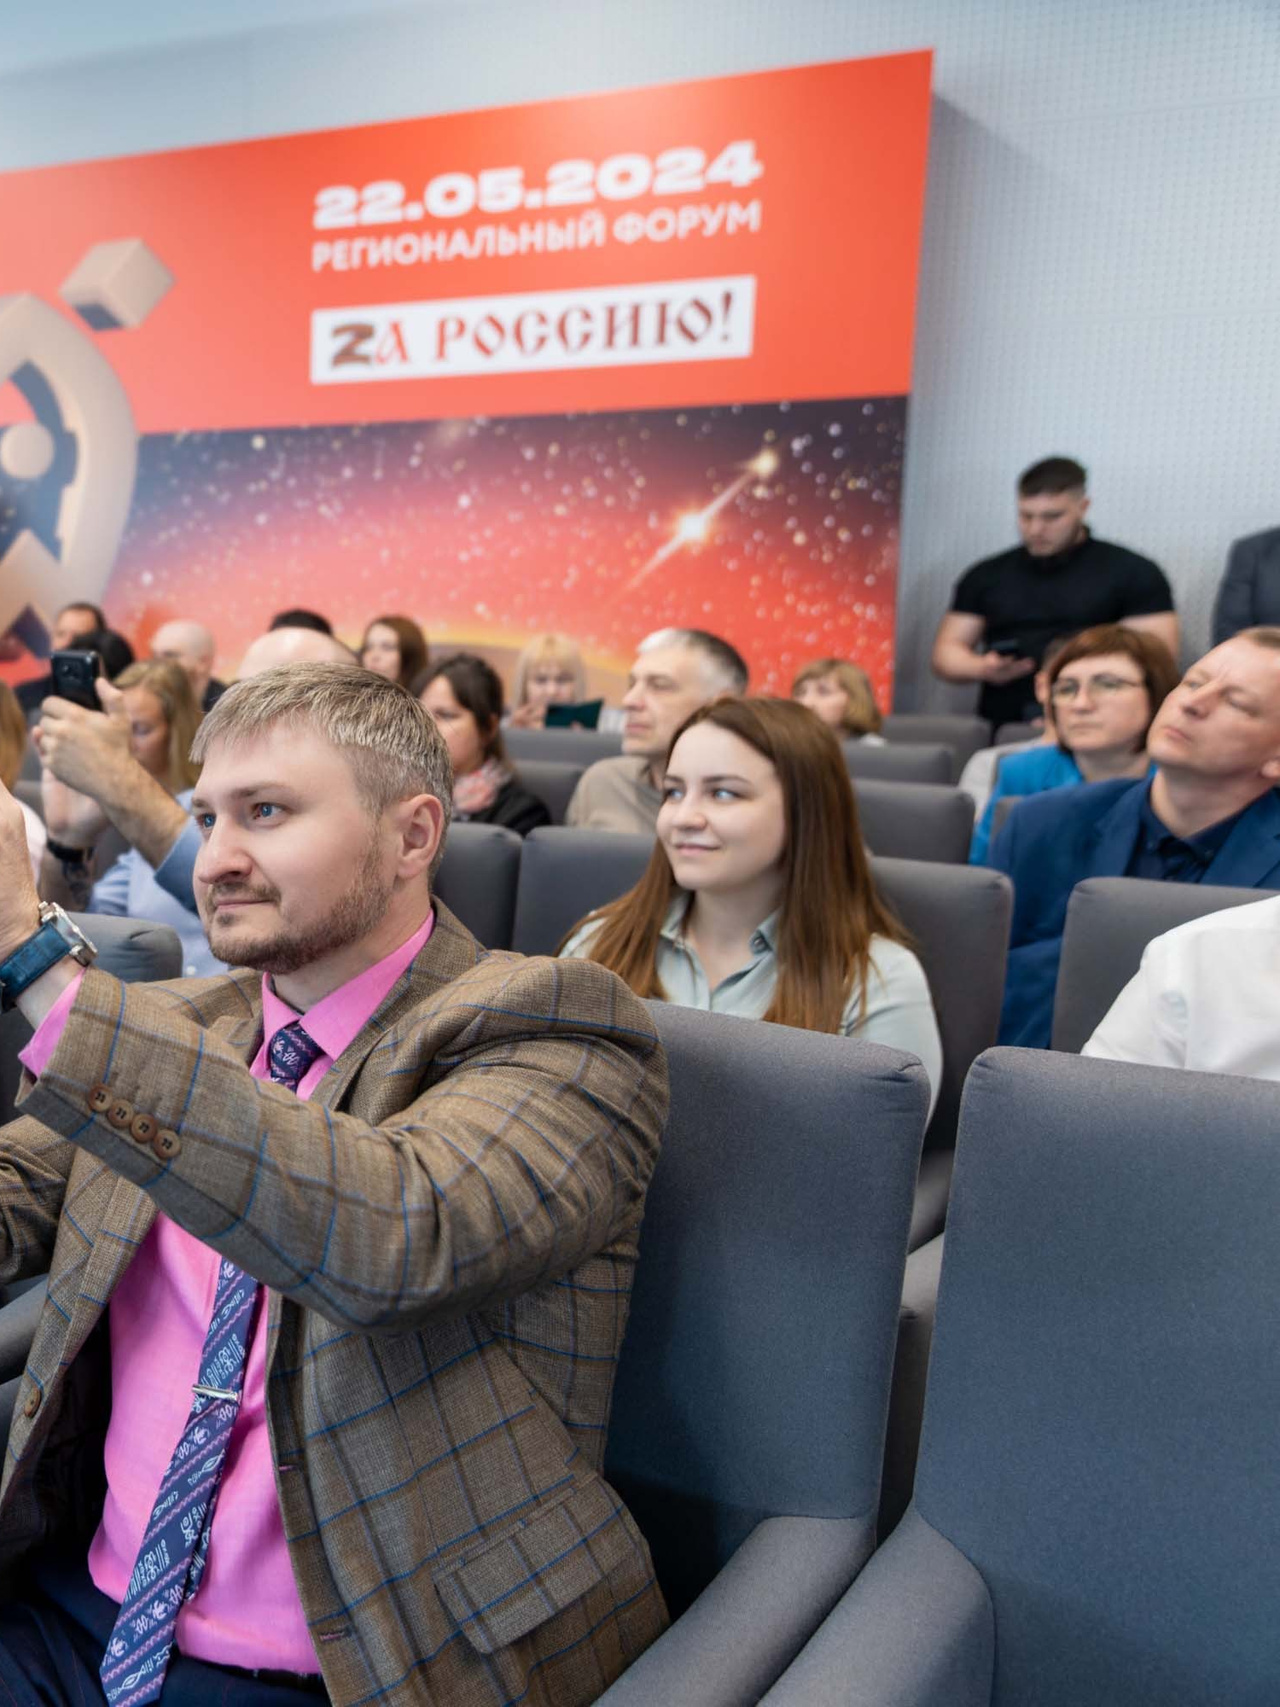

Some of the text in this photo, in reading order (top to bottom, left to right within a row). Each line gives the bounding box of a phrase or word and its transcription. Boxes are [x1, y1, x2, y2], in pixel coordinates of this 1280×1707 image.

[312, 139, 763, 231] 22.05.2024
[311, 199, 762, 273] РЕГИОНАЛЬНЫЙ ФОРУМ
[433, 290, 734, 361] РОССИЮ!
